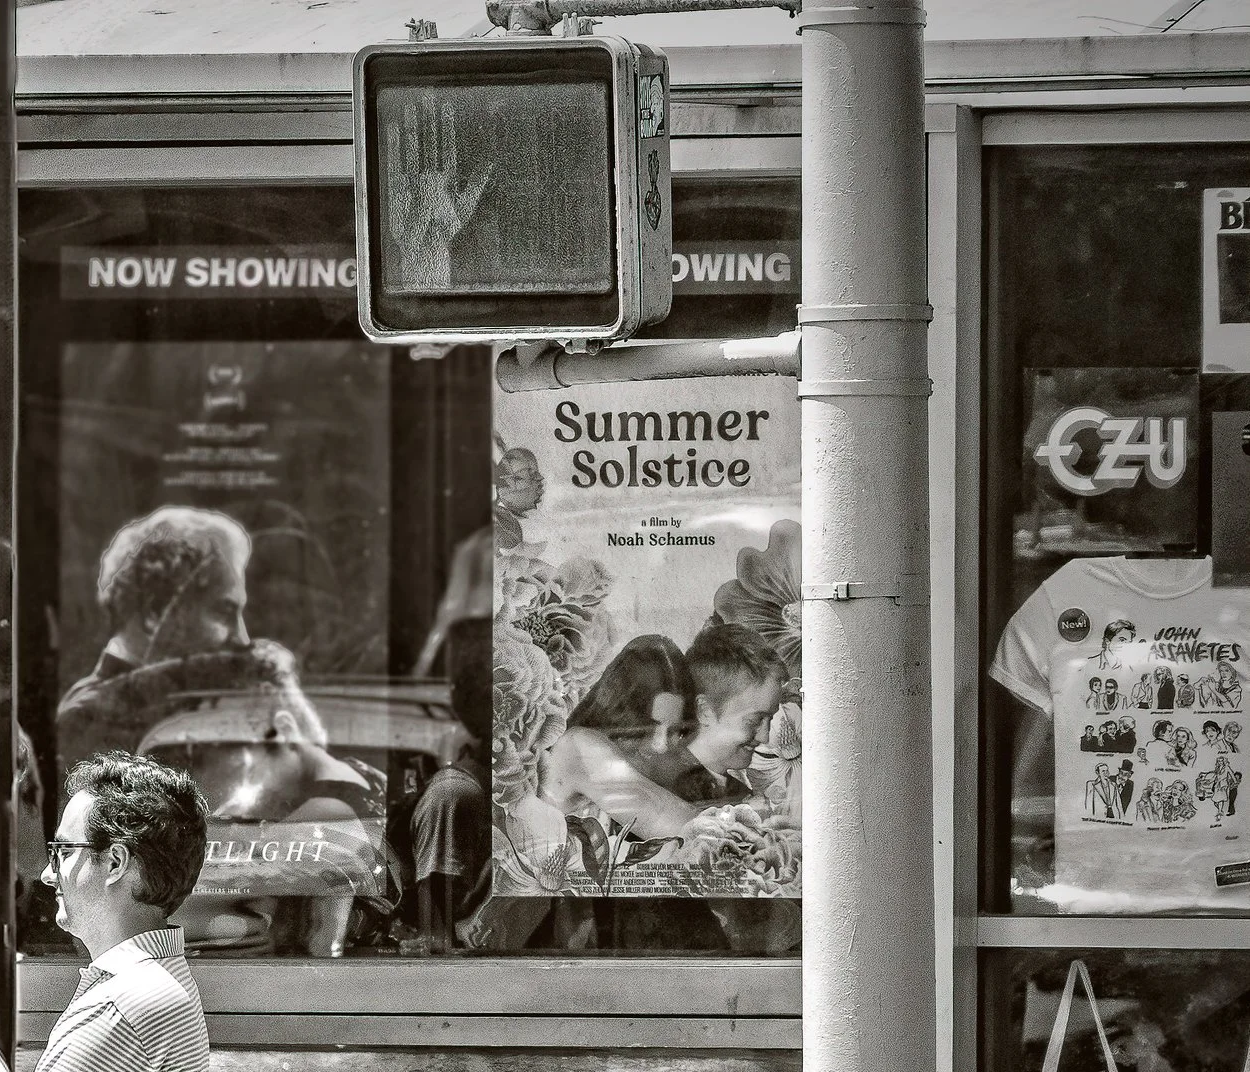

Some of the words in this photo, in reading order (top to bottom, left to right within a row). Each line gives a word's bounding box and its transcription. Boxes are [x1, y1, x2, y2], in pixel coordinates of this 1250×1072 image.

[88, 256, 177, 288] NOW
[185, 256, 358, 288] SHOWING
[671, 252, 791, 283] OWING
[553, 400, 770, 443] Summer
[571, 444, 752, 489] Solstice
[640, 519, 647, 527] a
[649, 517, 668, 527] film
[670, 517, 682, 529] by
[607, 532, 644, 546] Noah
[649, 532, 716, 546] Schamus
[1061, 612, 1087, 630] New!
[1153, 626, 1202, 642] JOHN
[1149, 640, 1242, 665] ASSAVETES
[206, 840, 329, 862] TLIGHT
